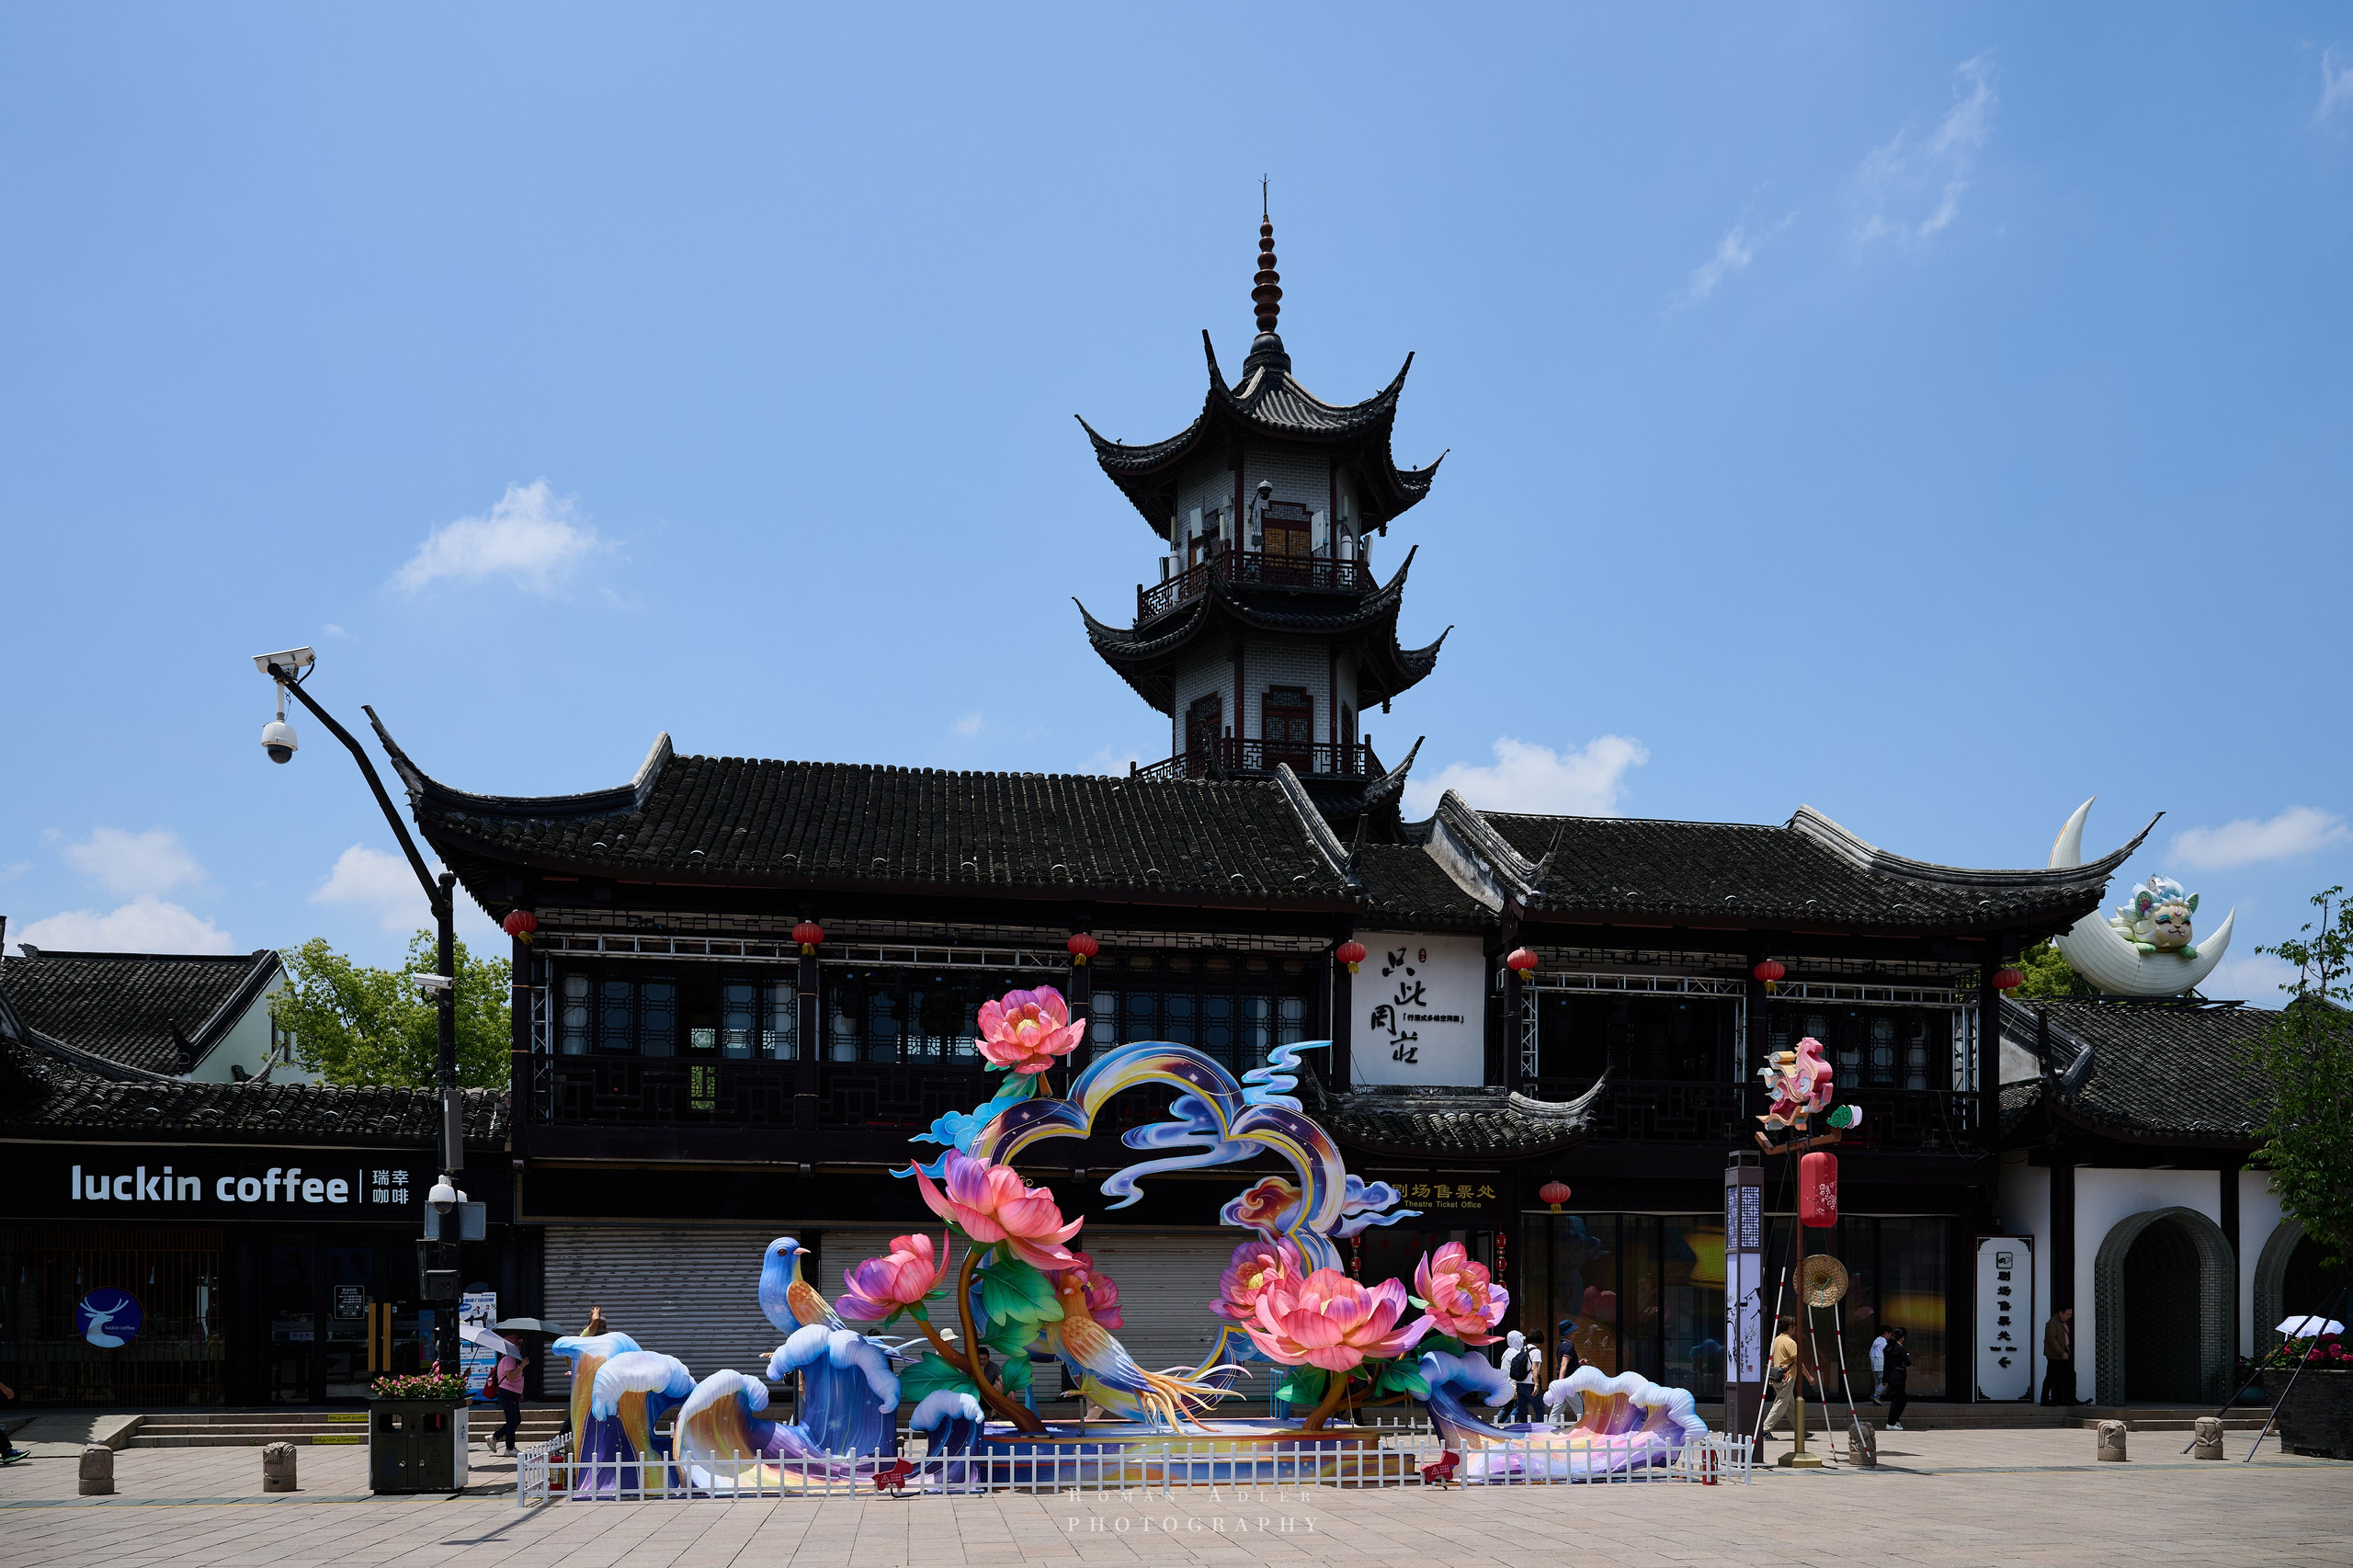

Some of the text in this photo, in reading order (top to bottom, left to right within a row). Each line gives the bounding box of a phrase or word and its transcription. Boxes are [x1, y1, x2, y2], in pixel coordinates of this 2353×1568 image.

[72, 1165, 348, 1203] luckin coffee
[372, 1169, 409, 1186] 瑞幸
[372, 1187, 409, 1204] 咖啡
[1404, 1199, 1433, 1208] Theatre
[1436, 1200, 1458, 1209] Ticket
